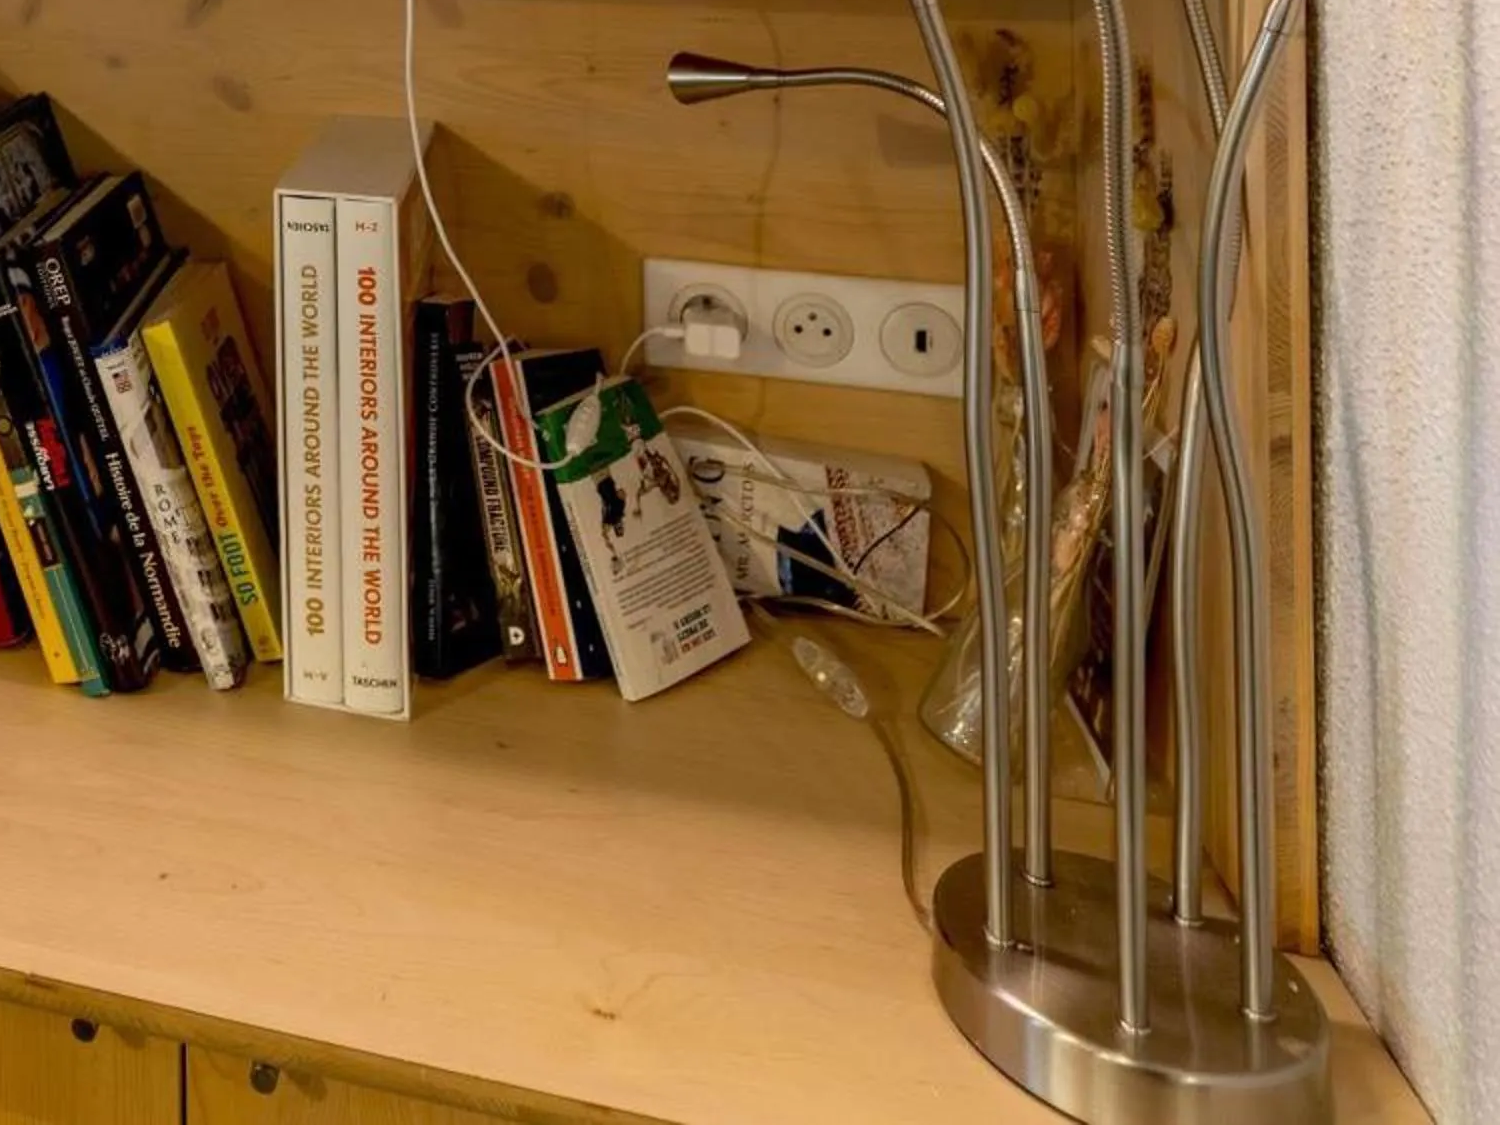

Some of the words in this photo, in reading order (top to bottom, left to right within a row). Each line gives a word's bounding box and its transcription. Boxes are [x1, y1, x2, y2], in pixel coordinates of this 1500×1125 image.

[45, 258, 71, 306] OREP
[301, 265, 319, 338] WORLD
[357, 267, 377, 306] 100
[302, 345, 320, 383] THE
[359, 314, 378, 422] INTERIORS
[26, 422, 55, 491] LAROUSSE
[304, 387, 321, 478] AROUND
[361, 426, 381, 520] AROUND
[105, 452, 133, 510] Histoire
[125, 512, 141, 531] de
[133, 532, 147, 548] la
[140, 551, 182, 650] Normandie
[218, 533, 251, 578] FOOT
[306, 484, 323, 589] INTERIORS
[363, 527, 381, 562] THE
[235, 582, 259, 606] SO
[306, 597, 325, 636] 100
[364, 569, 383, 645] WORLD
[352, 676, 397, 688] TASCHEN
